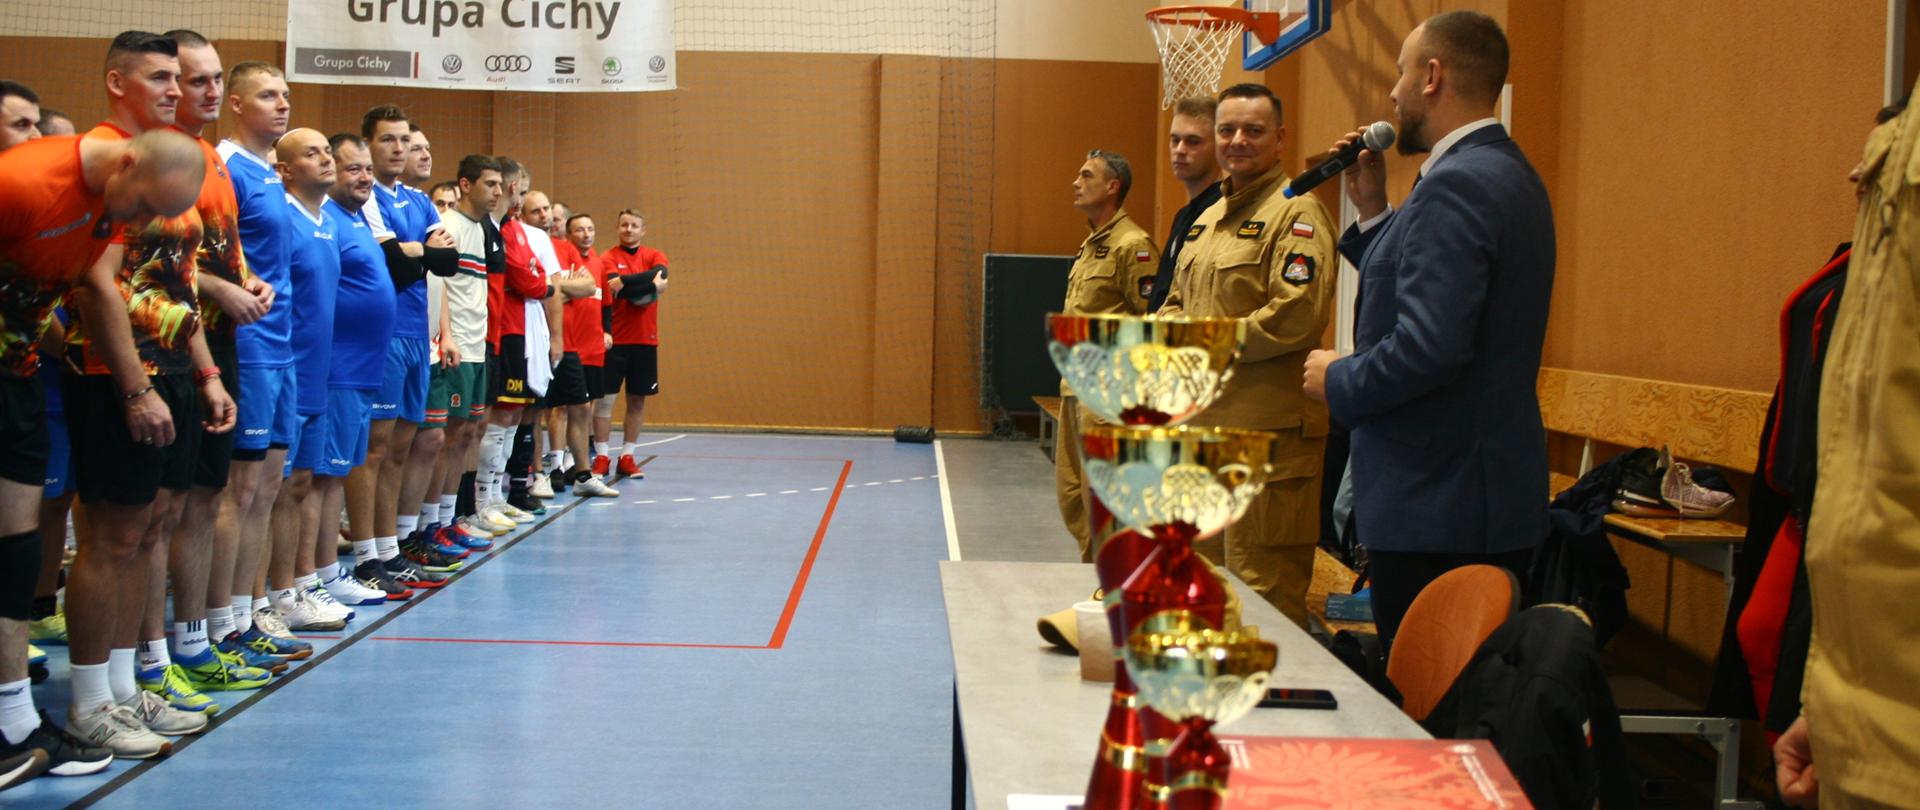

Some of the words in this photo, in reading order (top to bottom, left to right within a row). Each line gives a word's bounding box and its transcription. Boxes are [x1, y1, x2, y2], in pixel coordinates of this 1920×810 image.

[347, 0, 484, 37] Grupa
[500, 0, 621, 40] Cichy
[313, 54, 354, 70] Grupa
[356, 56, 392, 72] Cichy
[547, 77, 582, 85] SEAT
